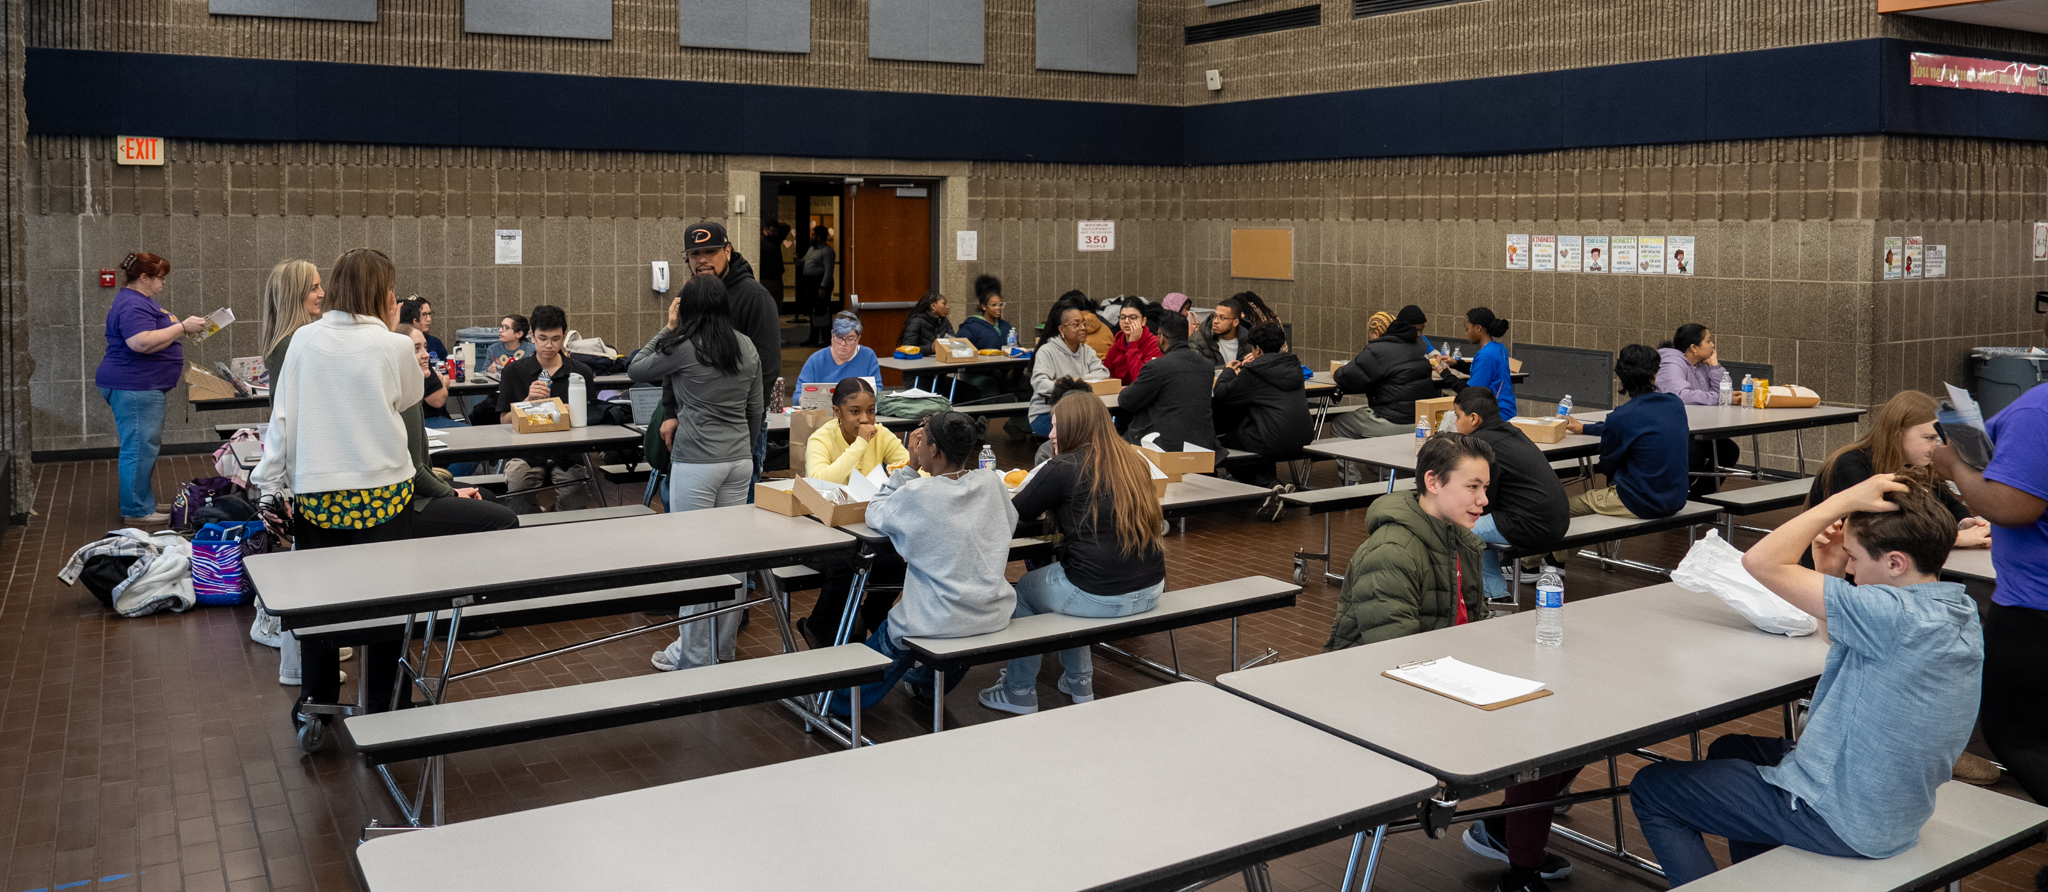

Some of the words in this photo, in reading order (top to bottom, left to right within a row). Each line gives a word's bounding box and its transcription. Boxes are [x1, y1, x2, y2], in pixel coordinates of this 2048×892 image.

[1911, 61, 1929, 79] You
[1954, 65, 1979, 83] kn
[2022, 75, 2037, 90] you
[2037, 69, 2048, 84] CA
[126, 138, 158, 160] EXIT
[1085, 235, 1108, 244] 350
